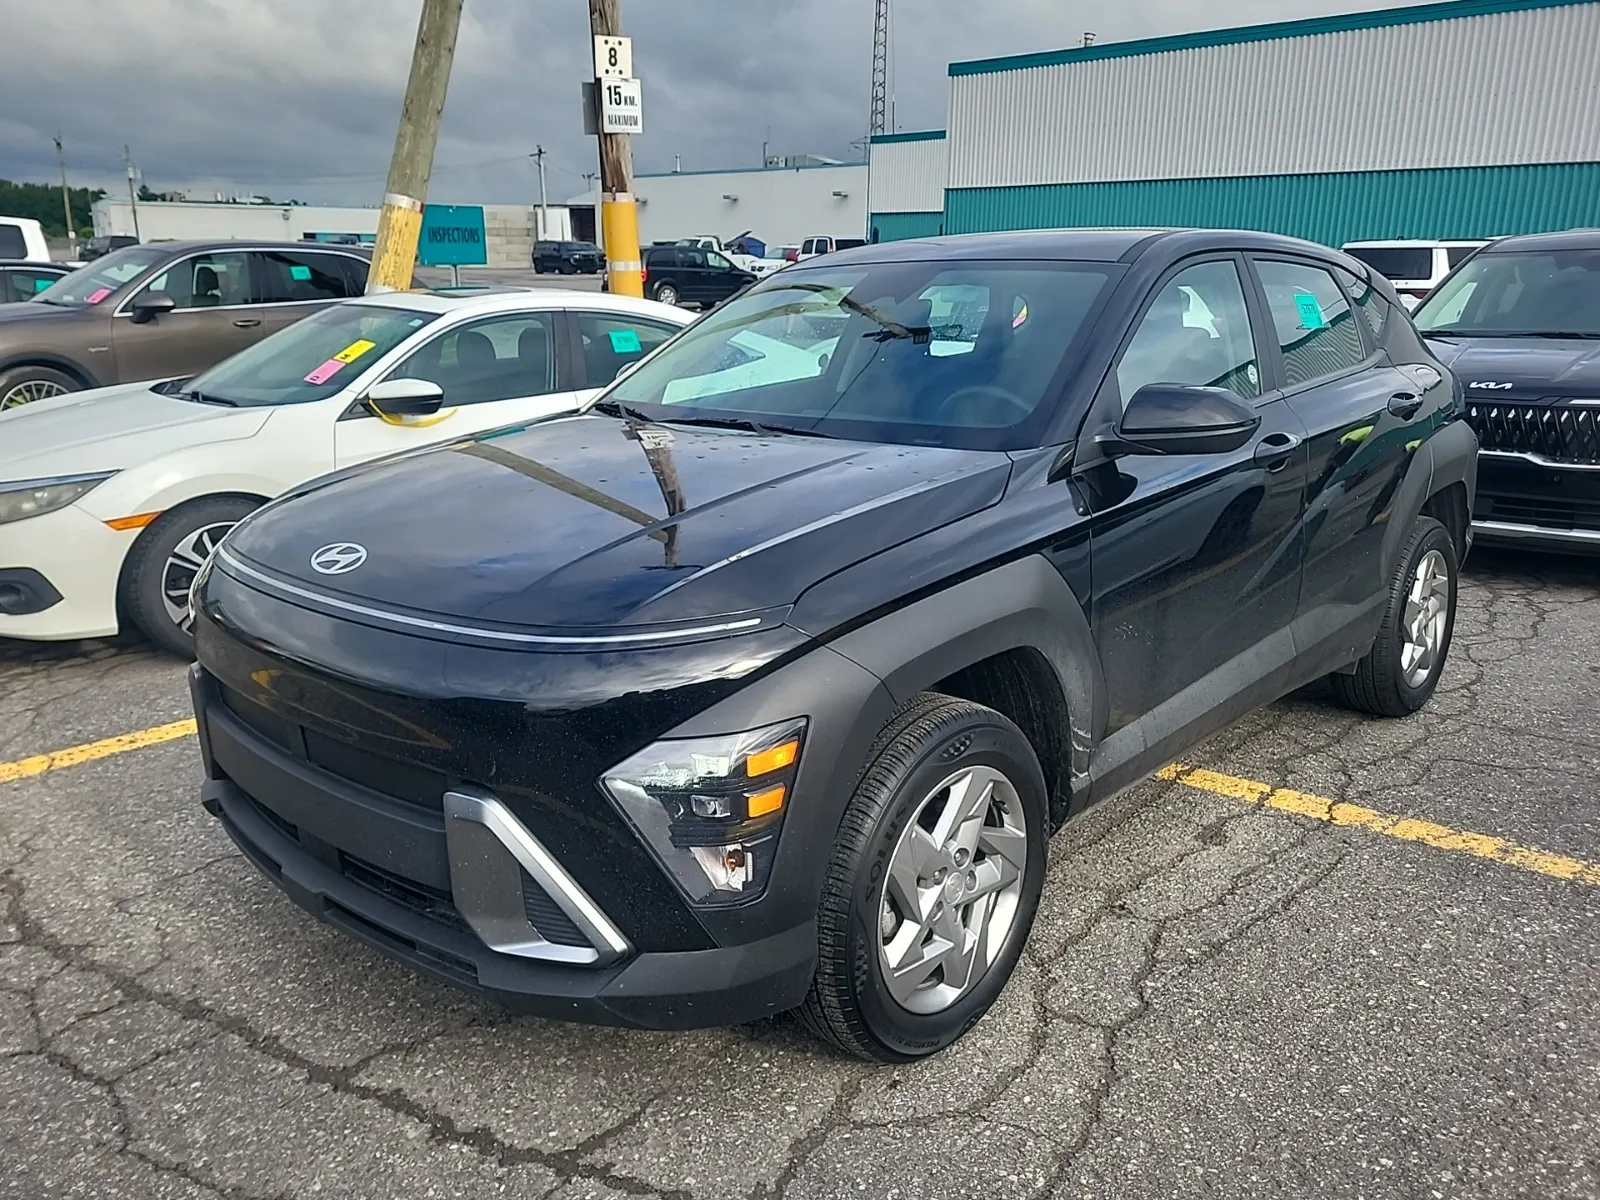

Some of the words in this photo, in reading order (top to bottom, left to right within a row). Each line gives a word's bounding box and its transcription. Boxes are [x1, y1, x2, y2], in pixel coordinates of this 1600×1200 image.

[608, 47, 618, 67] 8
[606, 85, 622, 105] 15
[608, 115, 638, 125] MAXIMUM
[428, 226, 480, 243] INSPECTIONS
[1469, 381, 1513, 390] KIA
